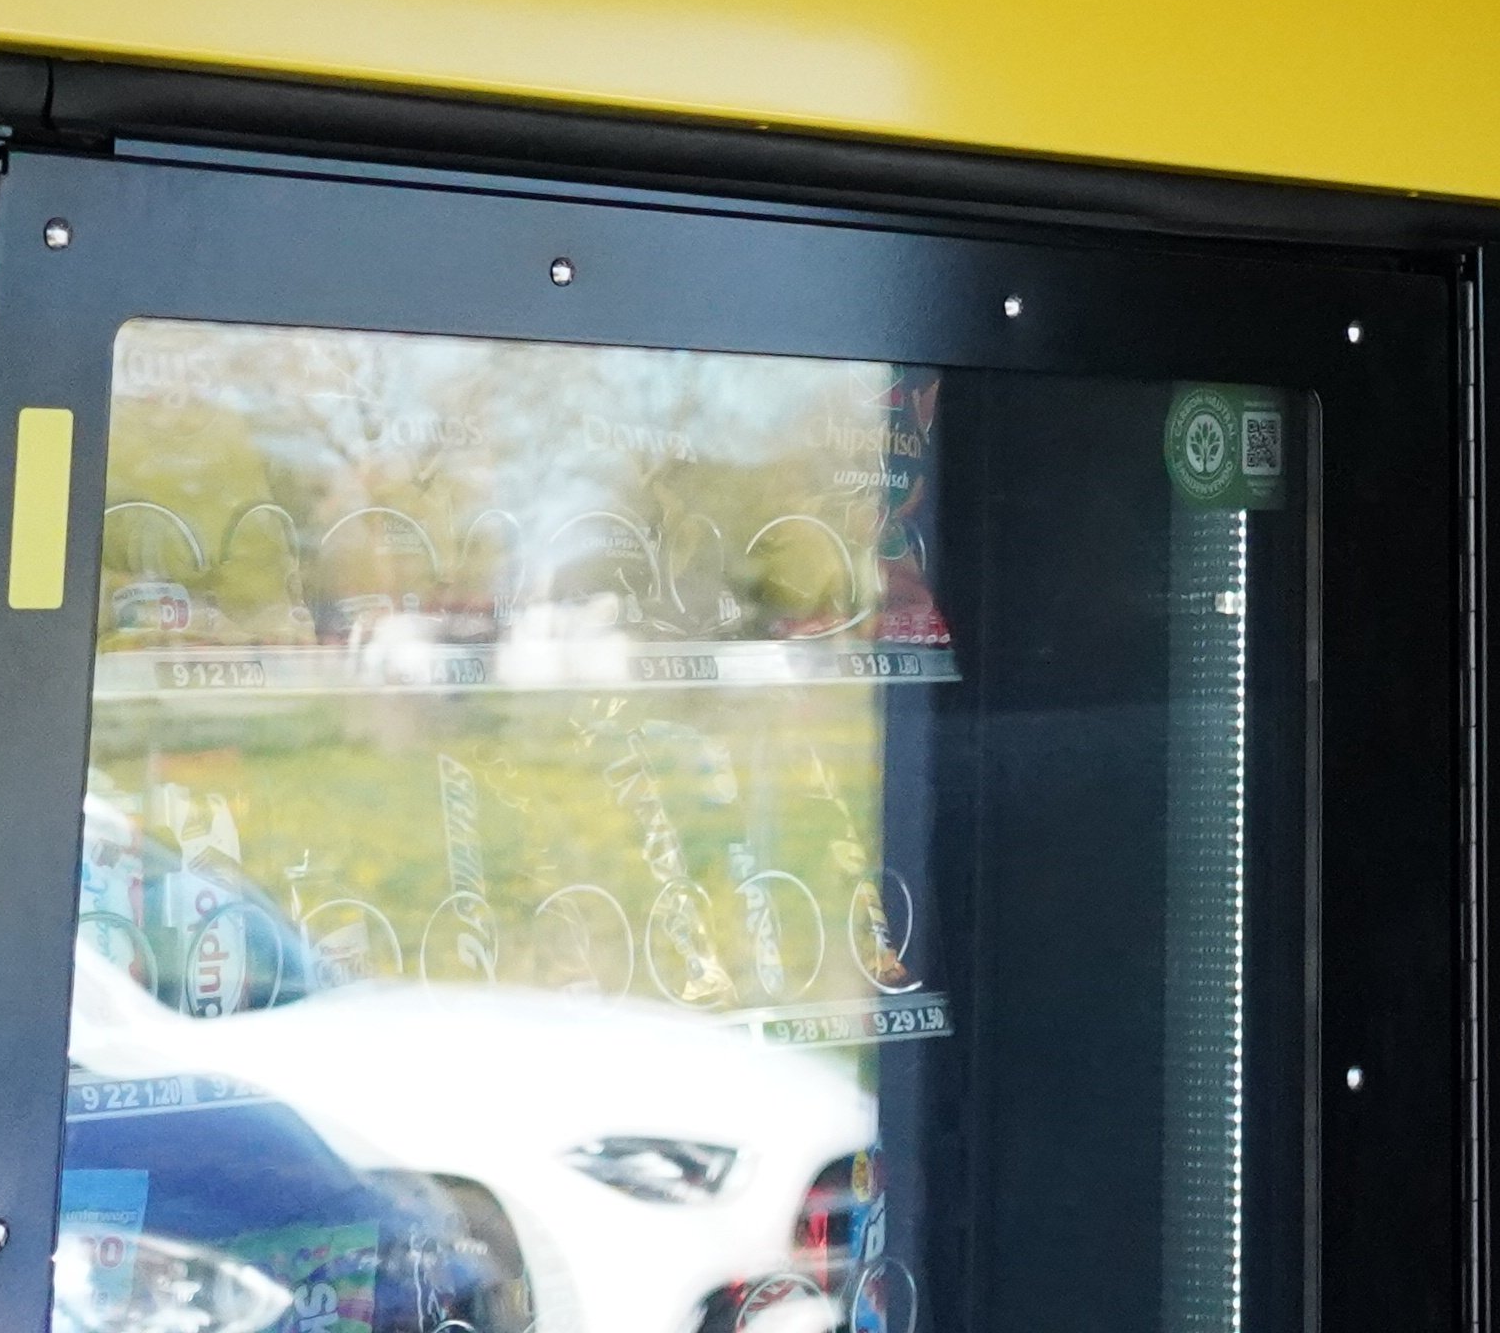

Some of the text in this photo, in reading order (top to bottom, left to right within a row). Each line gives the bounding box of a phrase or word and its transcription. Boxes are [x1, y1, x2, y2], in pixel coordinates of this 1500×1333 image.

[833, 467, 910, 491] ungarisch
[172, 663, 190, 688] 9
[193, 663, 227, 688] 12
[642, 656, 656, 681] 9
[661, 656, 686, 680] 16
[852, 655, 865, 678] 9
[866, 655, 891, 677] 18
[776, 1022, 791, 1045] 9
[792, 1020, 819, 1043] 28
[874, 1007, 946, 1034] 9 29 1.50
[81, 1077, 182, 1112] 9 22 1.20
